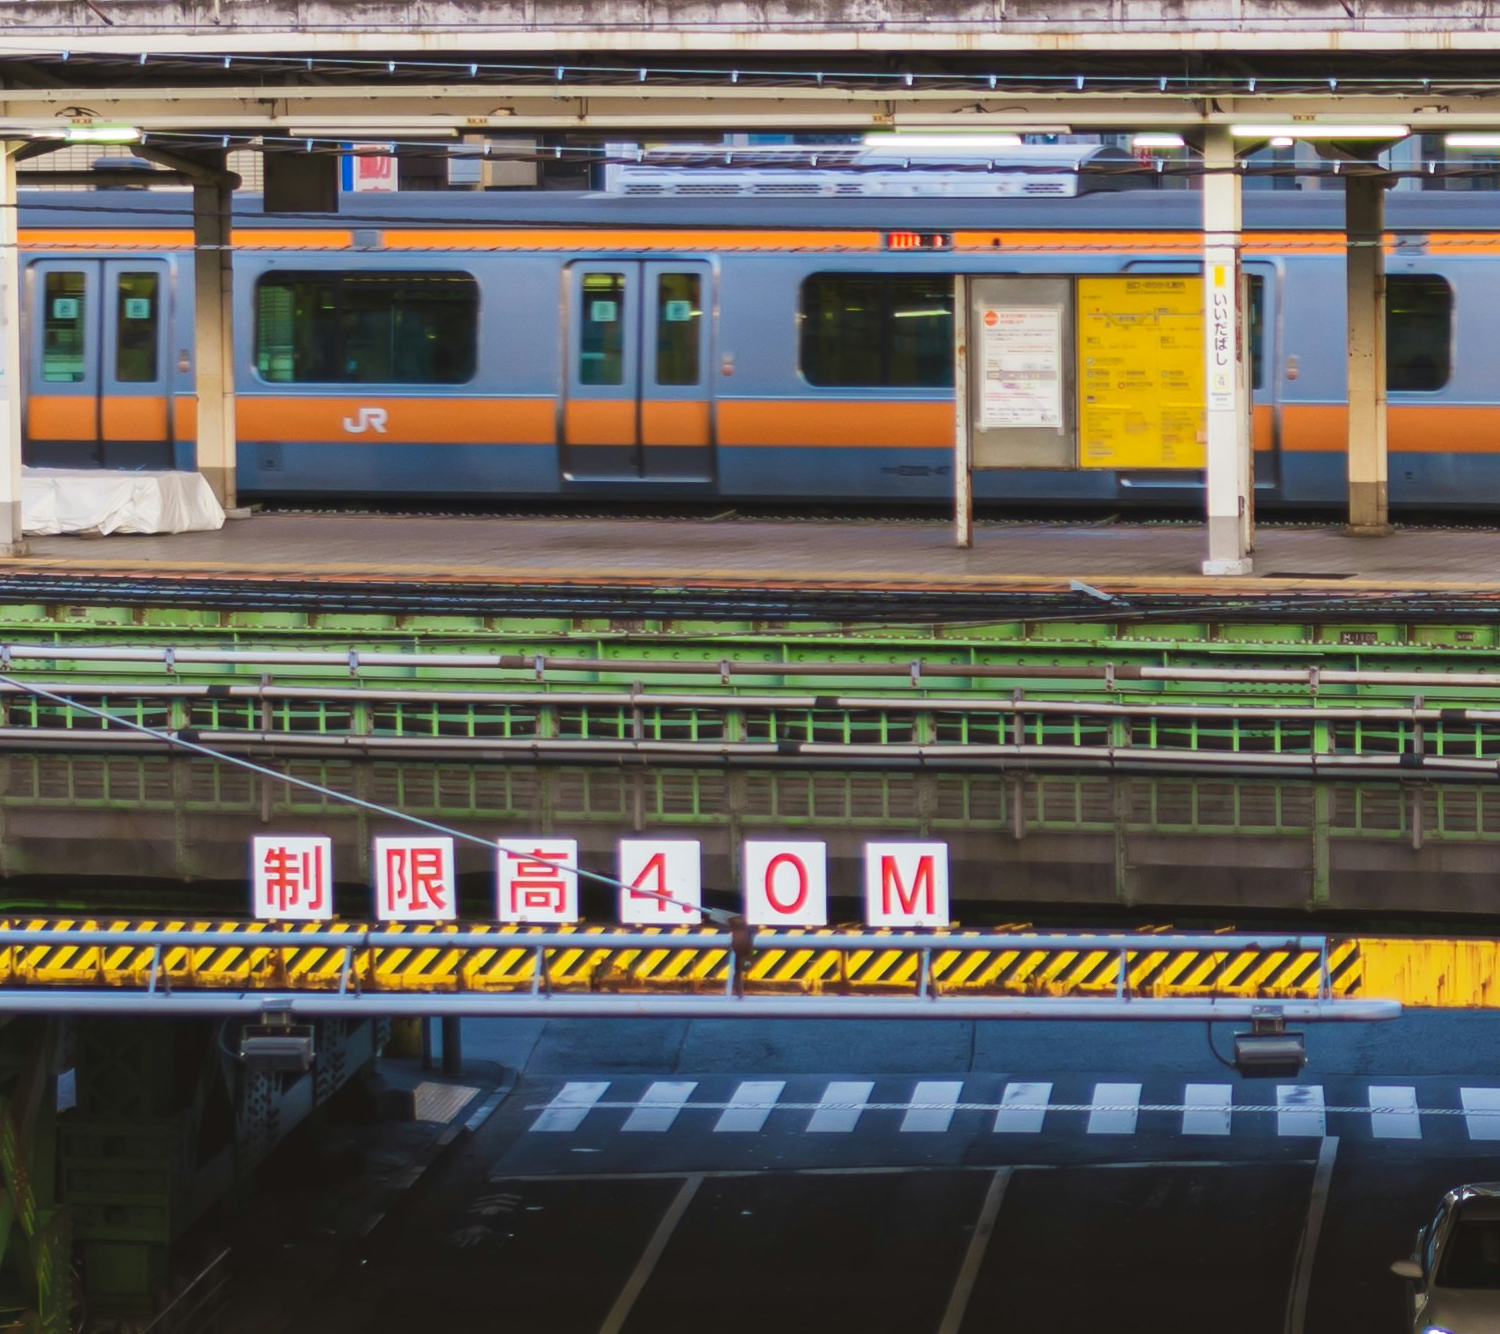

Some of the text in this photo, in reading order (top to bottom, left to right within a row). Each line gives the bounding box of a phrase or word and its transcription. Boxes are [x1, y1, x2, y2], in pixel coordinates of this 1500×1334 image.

[1213, 293, 1228, 366] いいだばし
[342, 407, 388, 434] JR
